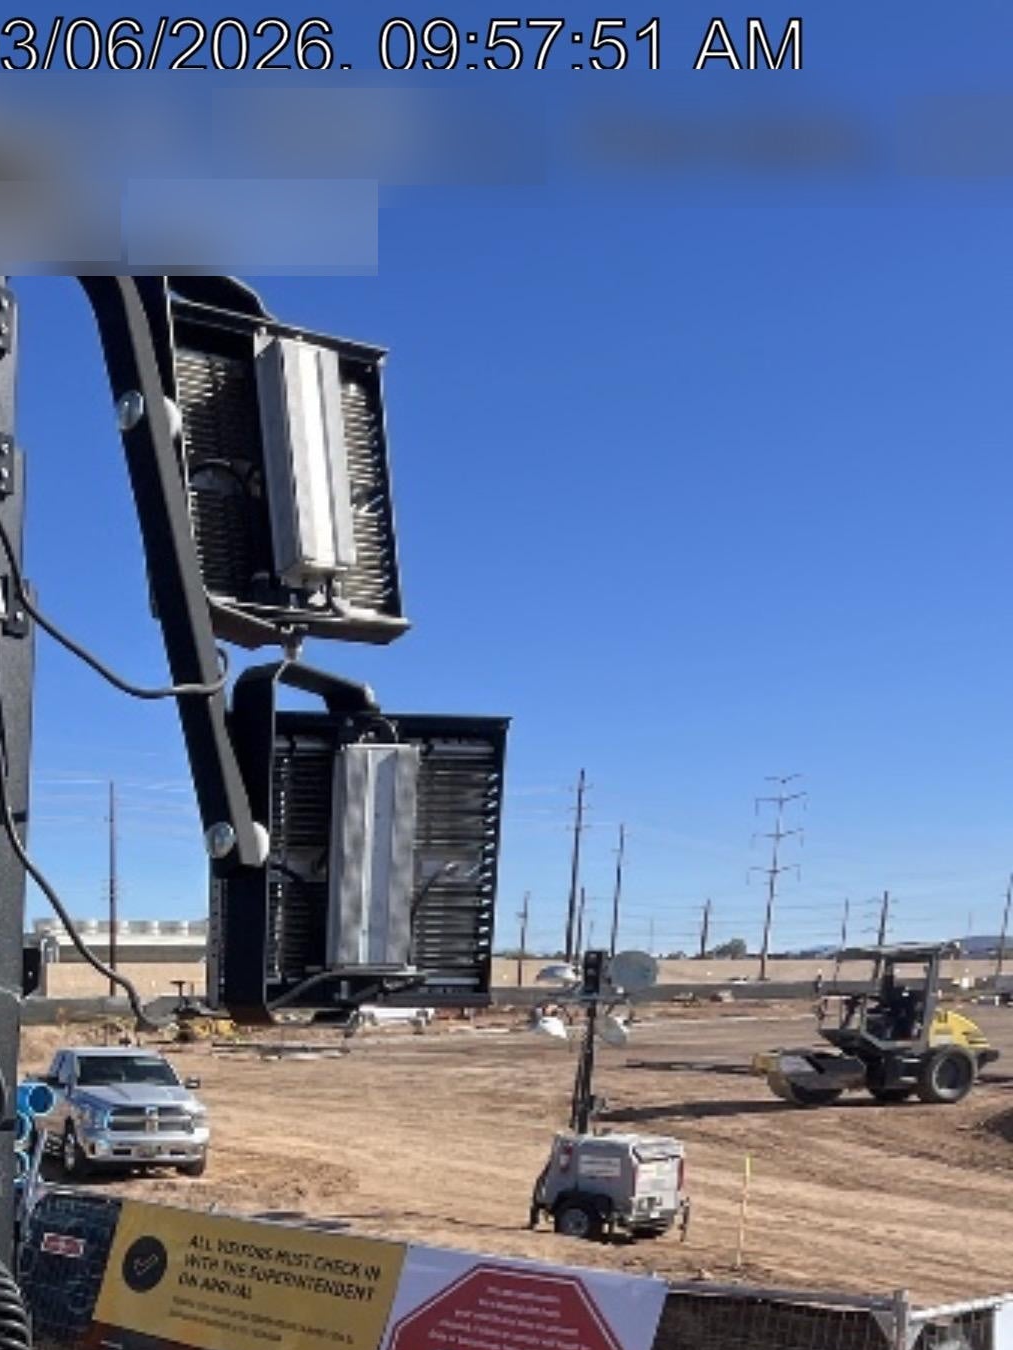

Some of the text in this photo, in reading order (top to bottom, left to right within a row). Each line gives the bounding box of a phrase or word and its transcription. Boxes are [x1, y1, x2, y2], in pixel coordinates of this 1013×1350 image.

[184, 1253, 375, 1302] WITH THE SUPERINTENDENT
[188, 1234, 380, 1282] ALL VISITORS MUST CHECK IN
[178, 1271, 252, 1300] ON ARRIVAL
